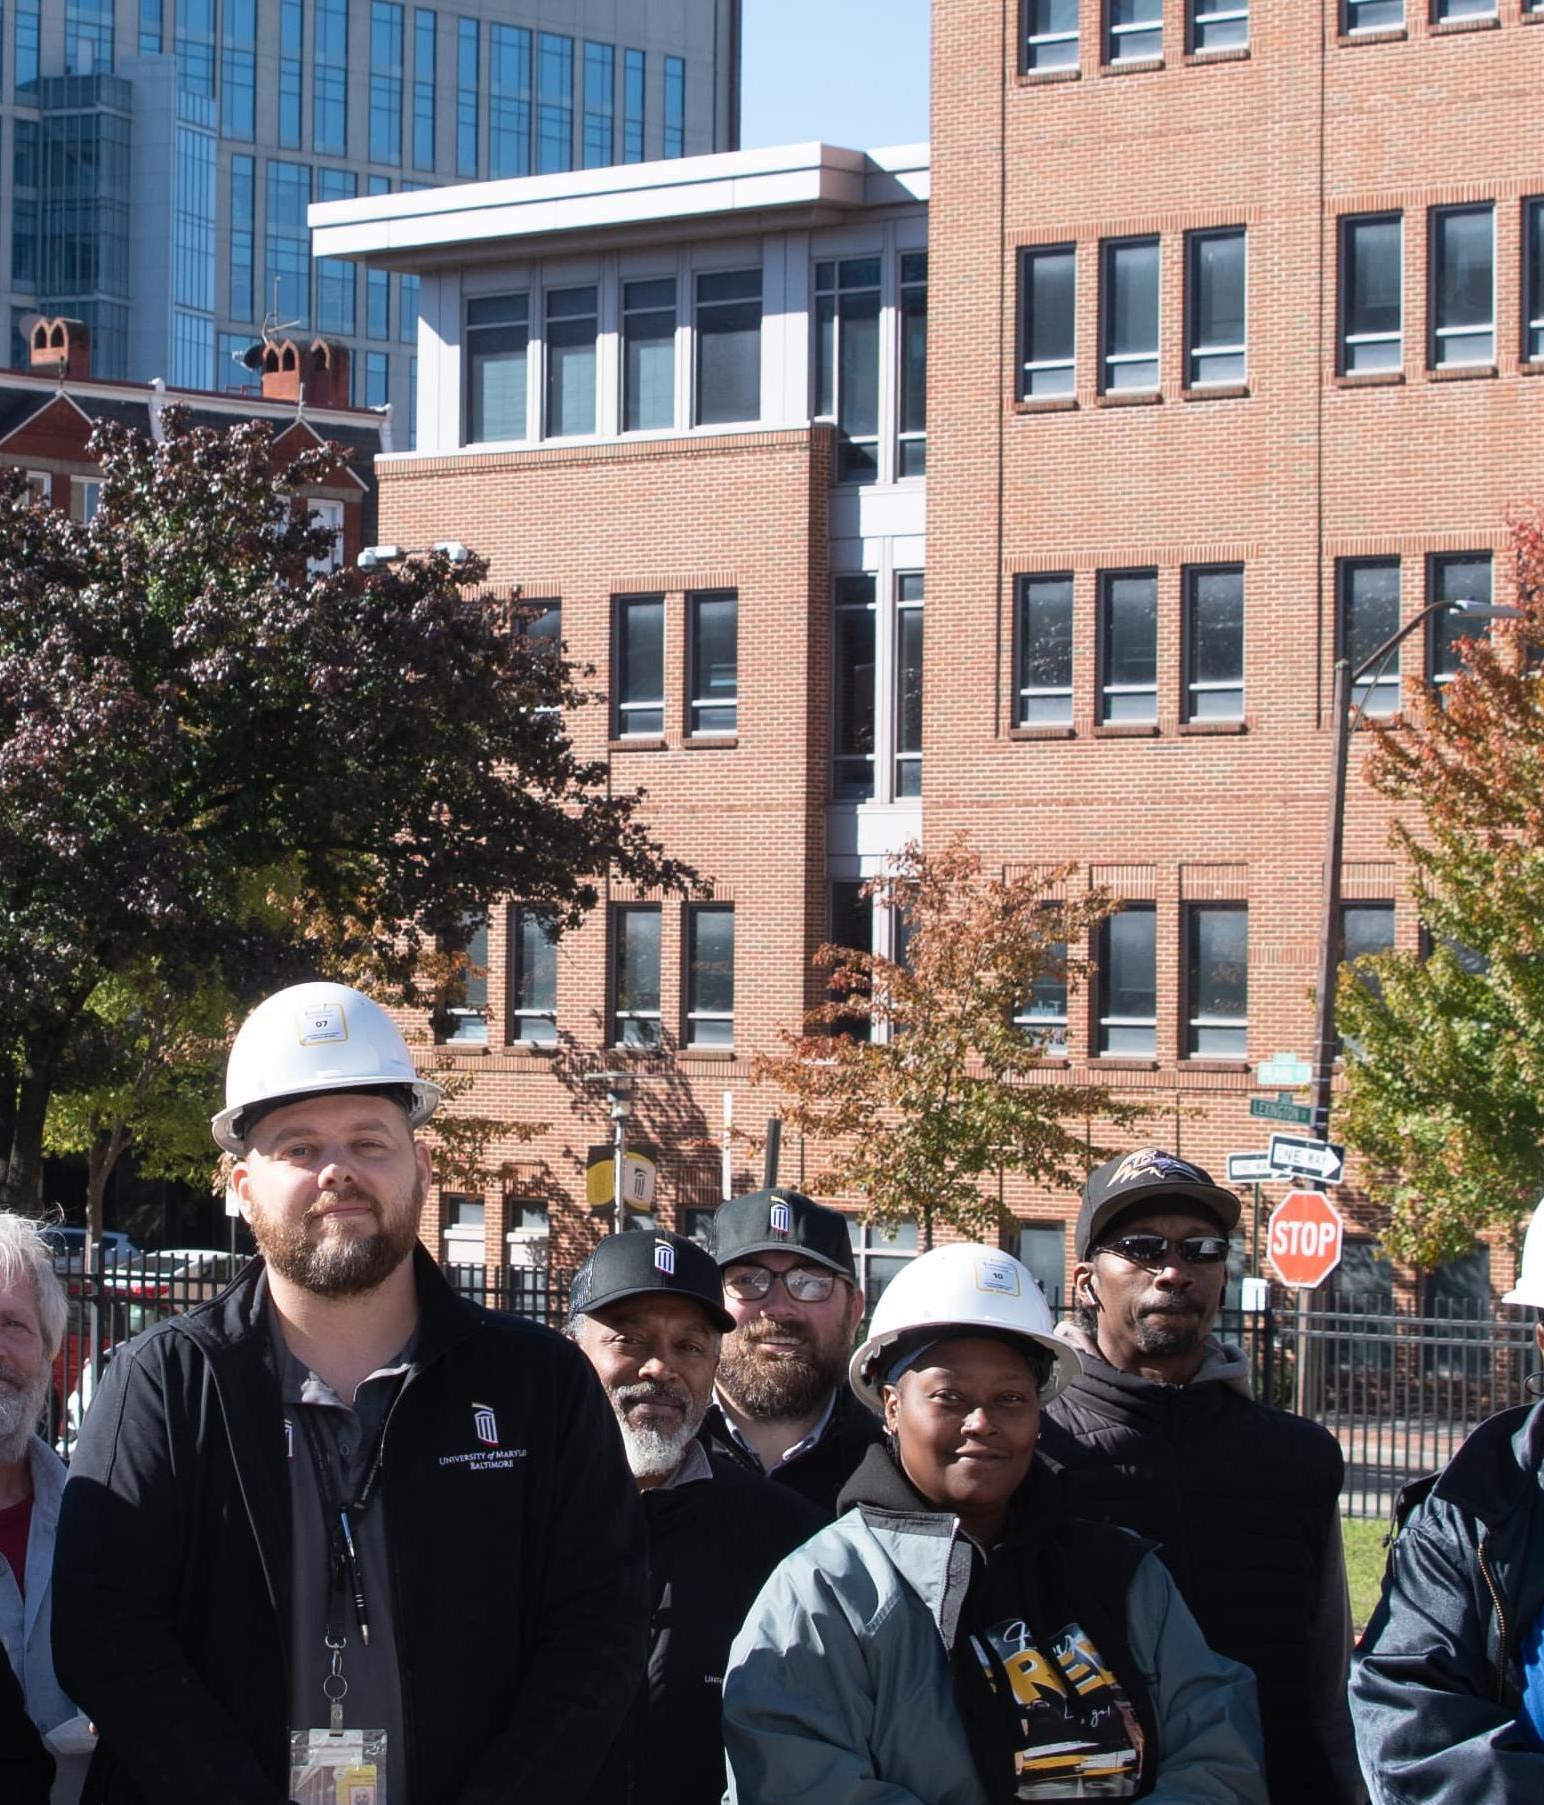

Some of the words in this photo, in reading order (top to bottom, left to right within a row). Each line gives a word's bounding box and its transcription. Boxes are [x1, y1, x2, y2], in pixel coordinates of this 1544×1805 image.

[315, 1020, 328, 1028] 07
[1273, 1220, 1336, 1257] STOP
[439, 1452, 486, 1465] UNIVERSITY
